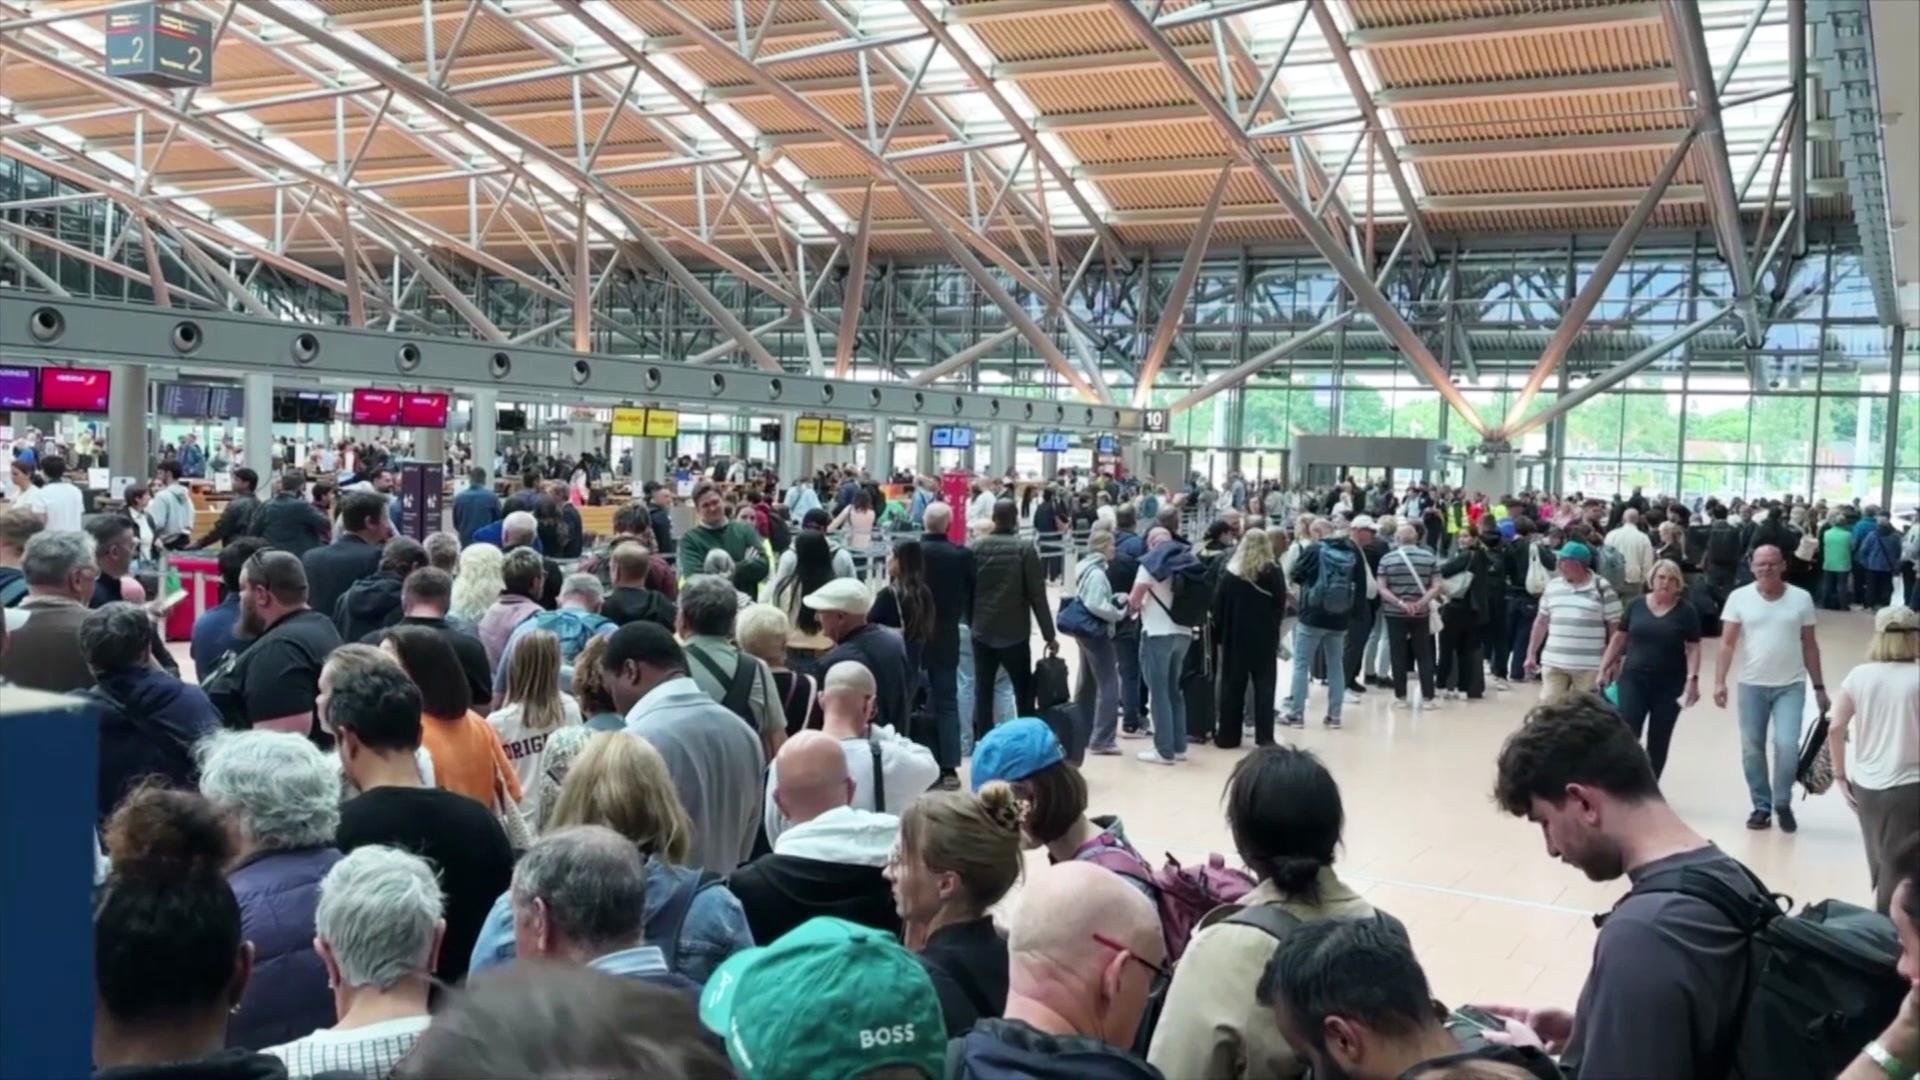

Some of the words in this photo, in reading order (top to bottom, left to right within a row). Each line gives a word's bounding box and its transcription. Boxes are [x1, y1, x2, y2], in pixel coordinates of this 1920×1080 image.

[132, 36, 144, 63] 2
[187, 46, 203, 74] 2
[1146, 411, 1162, 426] 10
[859, 1023, 916, 1050] BOSS
